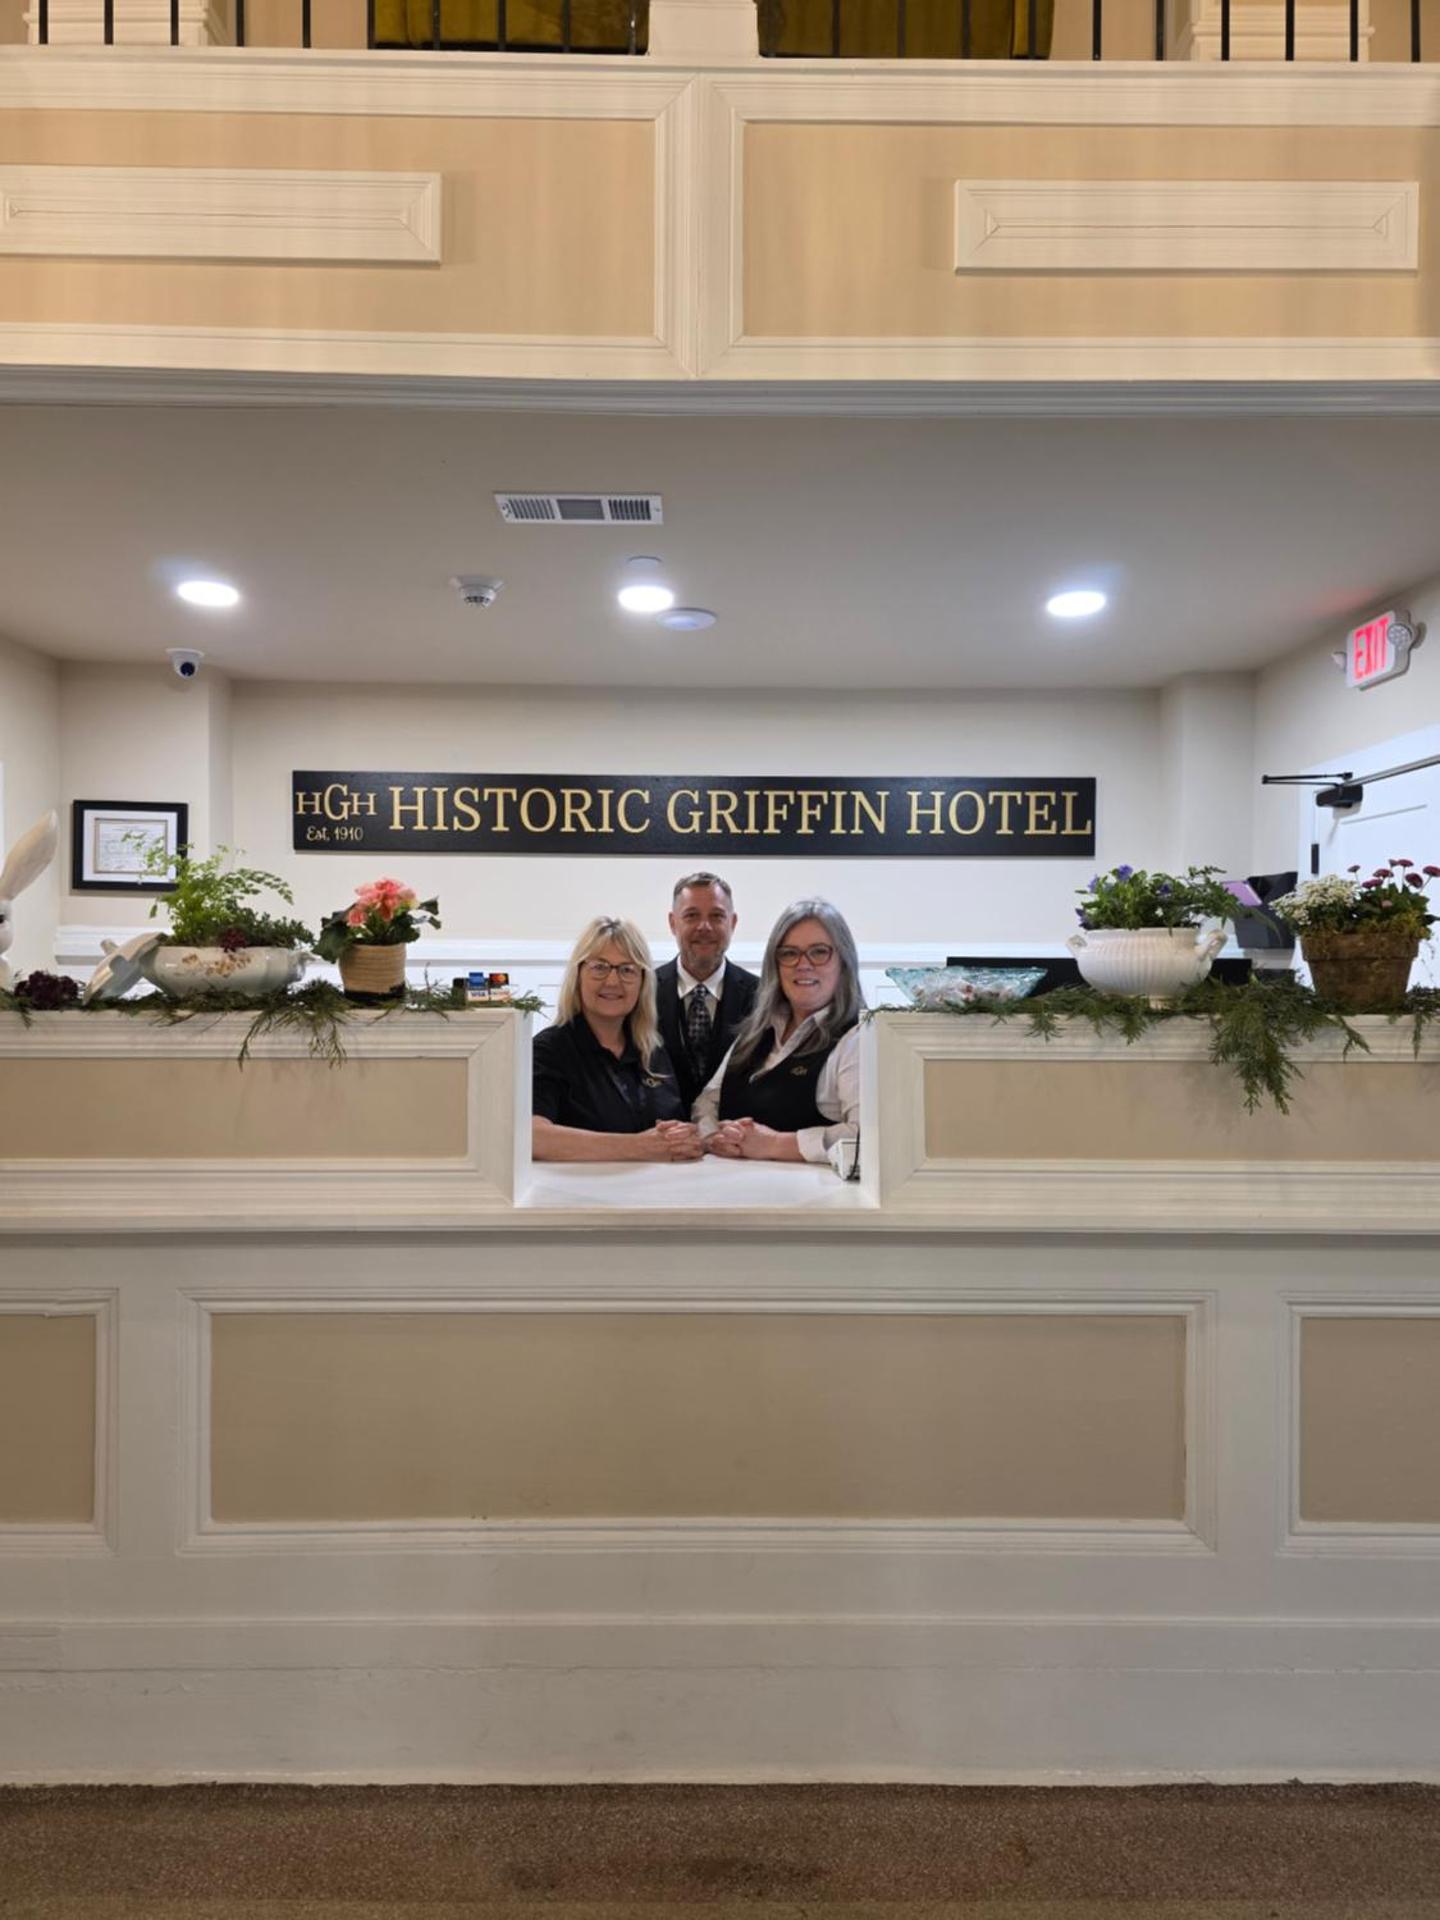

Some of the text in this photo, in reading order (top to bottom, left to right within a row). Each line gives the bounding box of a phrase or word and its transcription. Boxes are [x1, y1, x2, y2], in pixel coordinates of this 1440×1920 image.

[1353, 616, 1390, 680] EXIT
[295, 784, 376, 820] HGH
[388, 786, 1092, 836] HISTORIC GRIFFIN HOTEL
[334, 826, 363, 841] 1910
